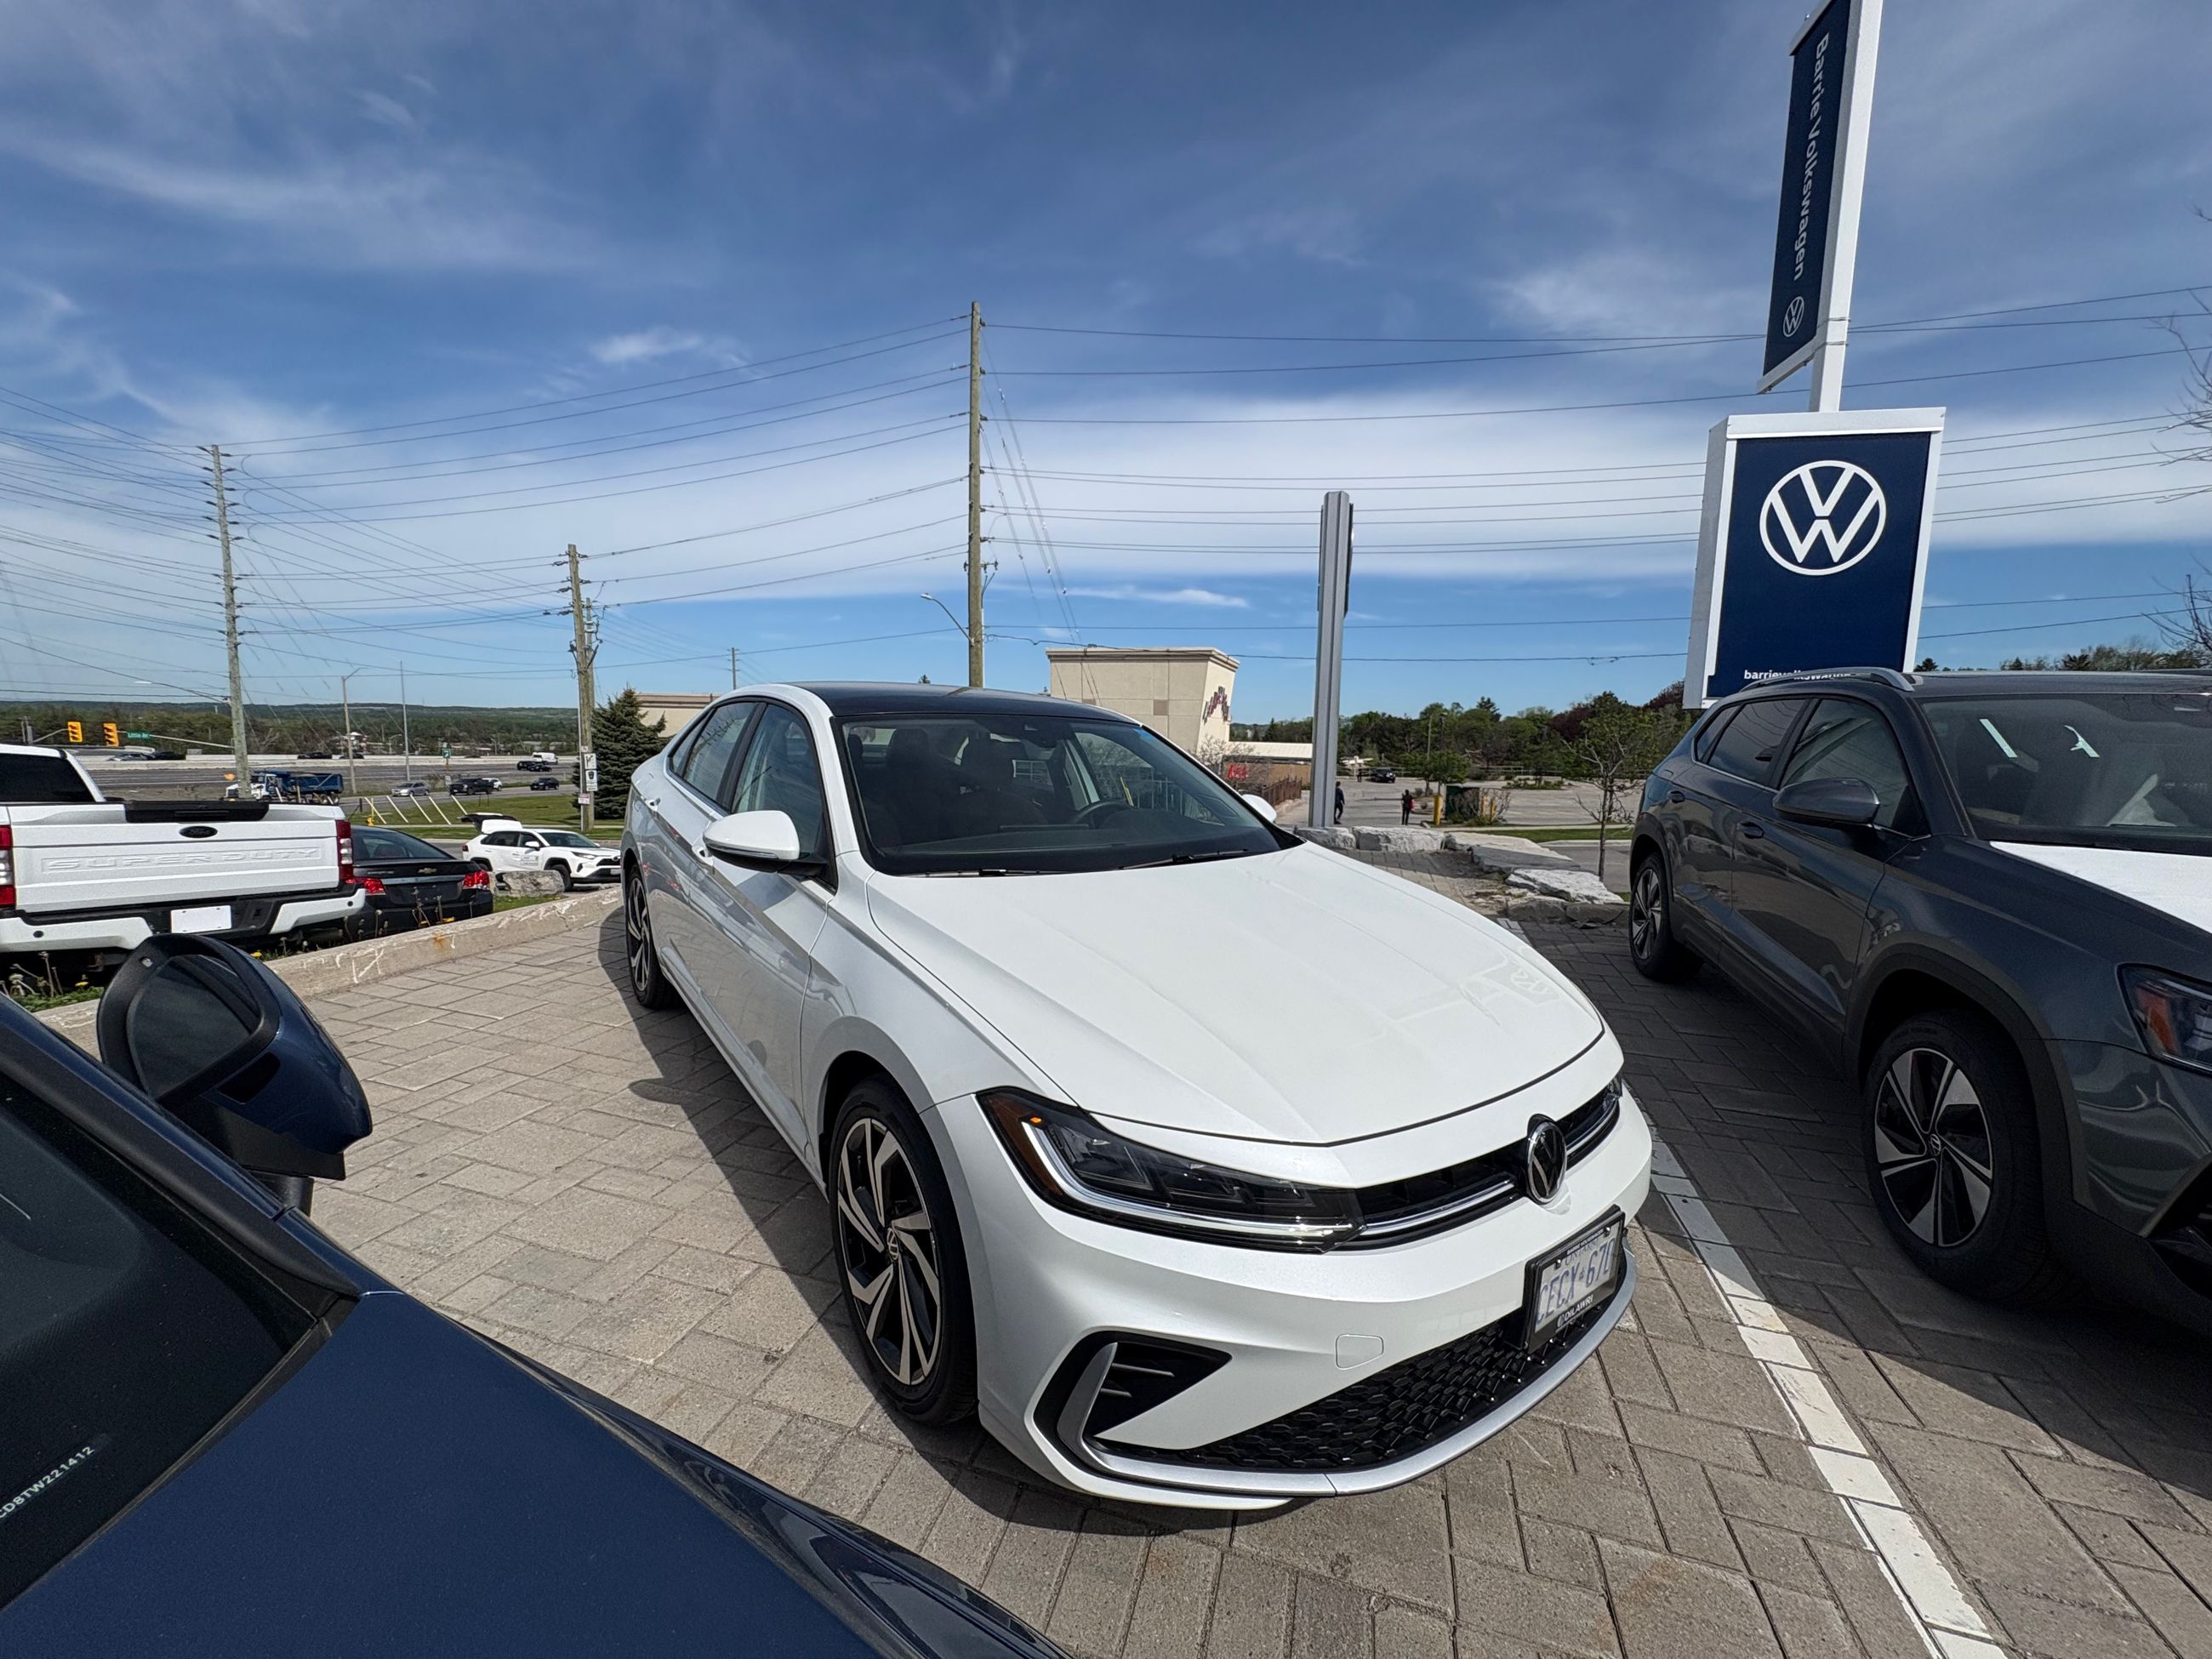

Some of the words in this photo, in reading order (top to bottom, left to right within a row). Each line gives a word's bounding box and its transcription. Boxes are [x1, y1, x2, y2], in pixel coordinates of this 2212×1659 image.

[1809, 31, 1830, 121] Barrie
[1793, 115, 1822, 281] Volkswagen
[47, 853, 212, 870] SUPER
[221, 849, 317, 862] DUTY
